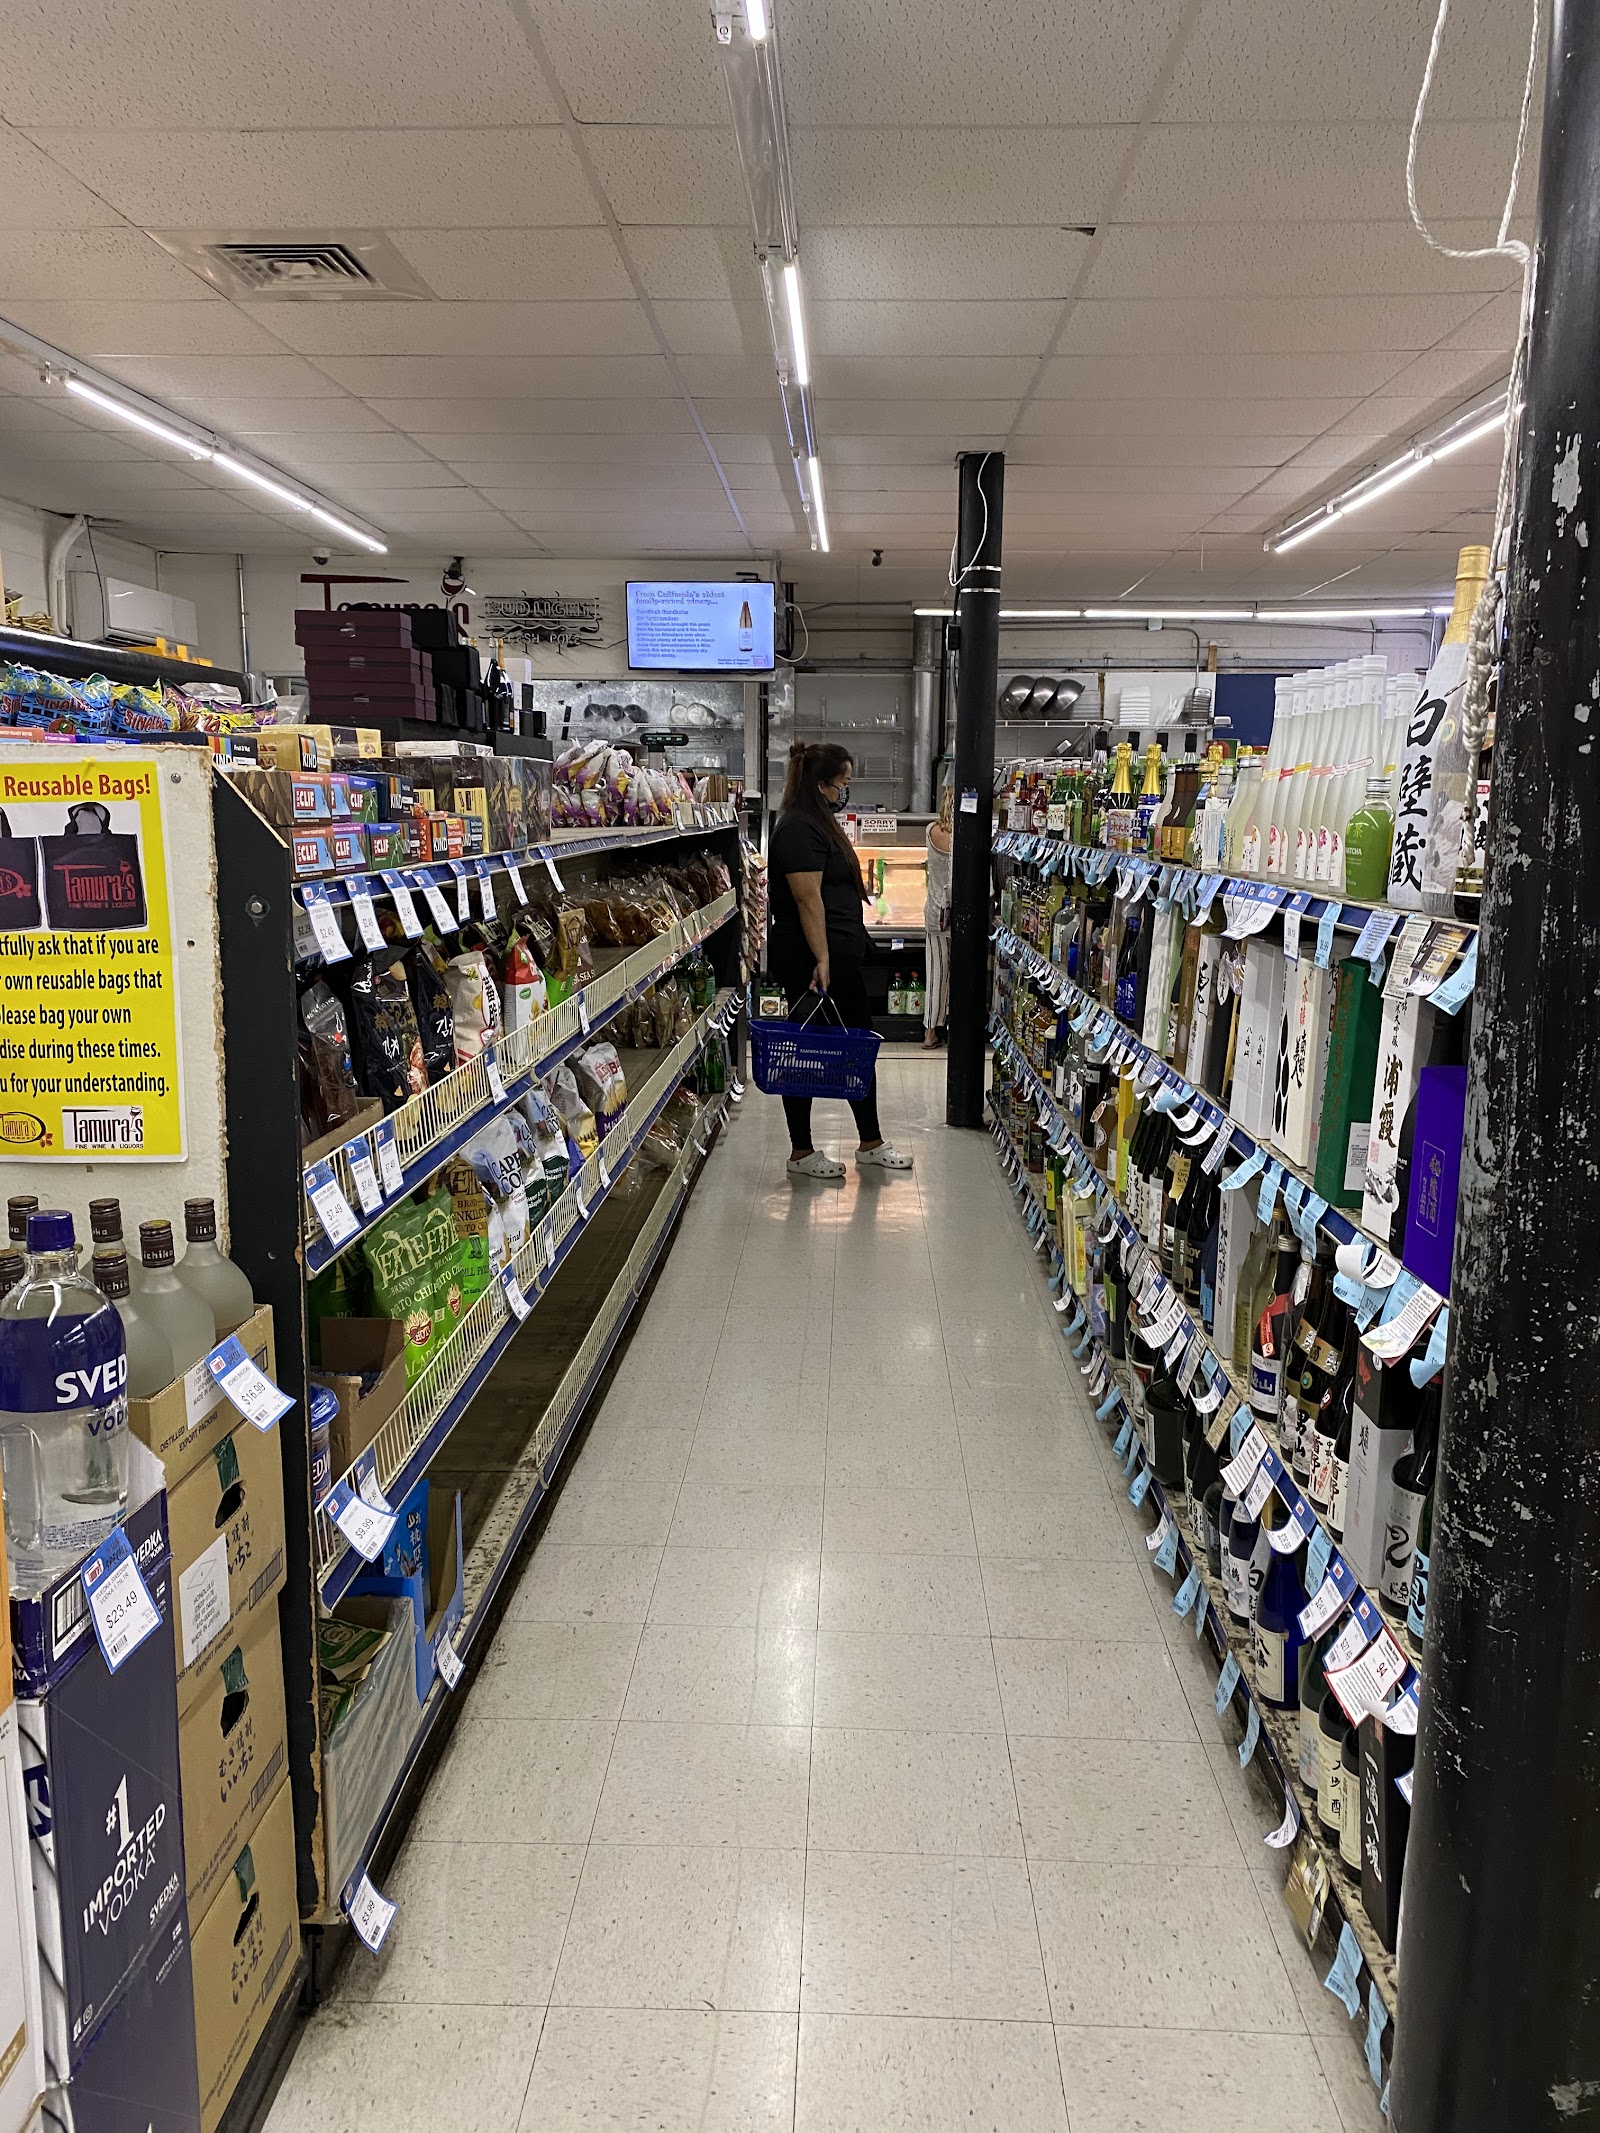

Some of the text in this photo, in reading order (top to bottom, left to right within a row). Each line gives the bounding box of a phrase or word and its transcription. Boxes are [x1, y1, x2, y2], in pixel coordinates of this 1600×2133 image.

[493, 601, 530, 616] BUD
[302, 754, 318, 768] KIND
[4, 773, 151, 800] Reusable Bags!
[300, 789, 315, 807] CLIF
[350, 793, 364, 808] CLIF
[300, 844, 318, 862] CLIF
[335, 839, 350, 857] CLIF
[376, 838, 389, 854] CLIF
[434, 838, 448, 852] KIND
[53, 861, 136, 903] Tamura's
[319, 926, 335, 939] $2.49
[37, 935, 61, 955] ask
[62, 934, 93, 954] that
[95, 934, 106, 954] if
[110, 938, 134, 960] you
[137, 938, 159, 954] are
[5, 975, 33, 990] own
[36, 969, 95, 990] reusable
[98, 968, 131, 994] bags
[133, 968, 163, 989] that
[39, 1004, 65, 1029] bag
[68, 1007, 99, 1030] your
[102, 1007, 132, 1024] own
[0, 1037, 161, 1064] dise during these times.
[10, 1072, 28, 1093] for
[31, 1076, 62, 1098] your
[65, 1071, 170, 1098] understanding.
[0, 1113, 37, 1137] Tamura's
[62, 1106, 144, 1143] Tamura's
[326, 1204, 343, 1221] $7.49
[391, 1276, 416, 1295] BRAND
[55, 1353, 127, 1403] SVED
[241, 1381, 266, 1405] $16.99
[160, 1425, 185, 1453] DISTILLED
[178, 1410, 219, 1452] EXPORT PACKING
[355, 1518, 374, 1540] $9.99
[105, 1545, 127, 1571] SPECIAL
[95, 1563, 129, 1600] SVEDKA SWEDISH
[100, 1589, 114, 1605] VODKA
[105, 1590, 138, 1629] $23.49
[195, 1654, 214, 1677] EXPORT
[214, 1626, 235, 1655] PACKING
[104, 1774, 134, 1856] #1
[82, 1802, 167, 1934] IMPORTED
[98, 1850, 153, 1937] VODKA
[148, 1872, 180, 1926] SVEDKA
[361, 1900, 376, 1926] $3.99
